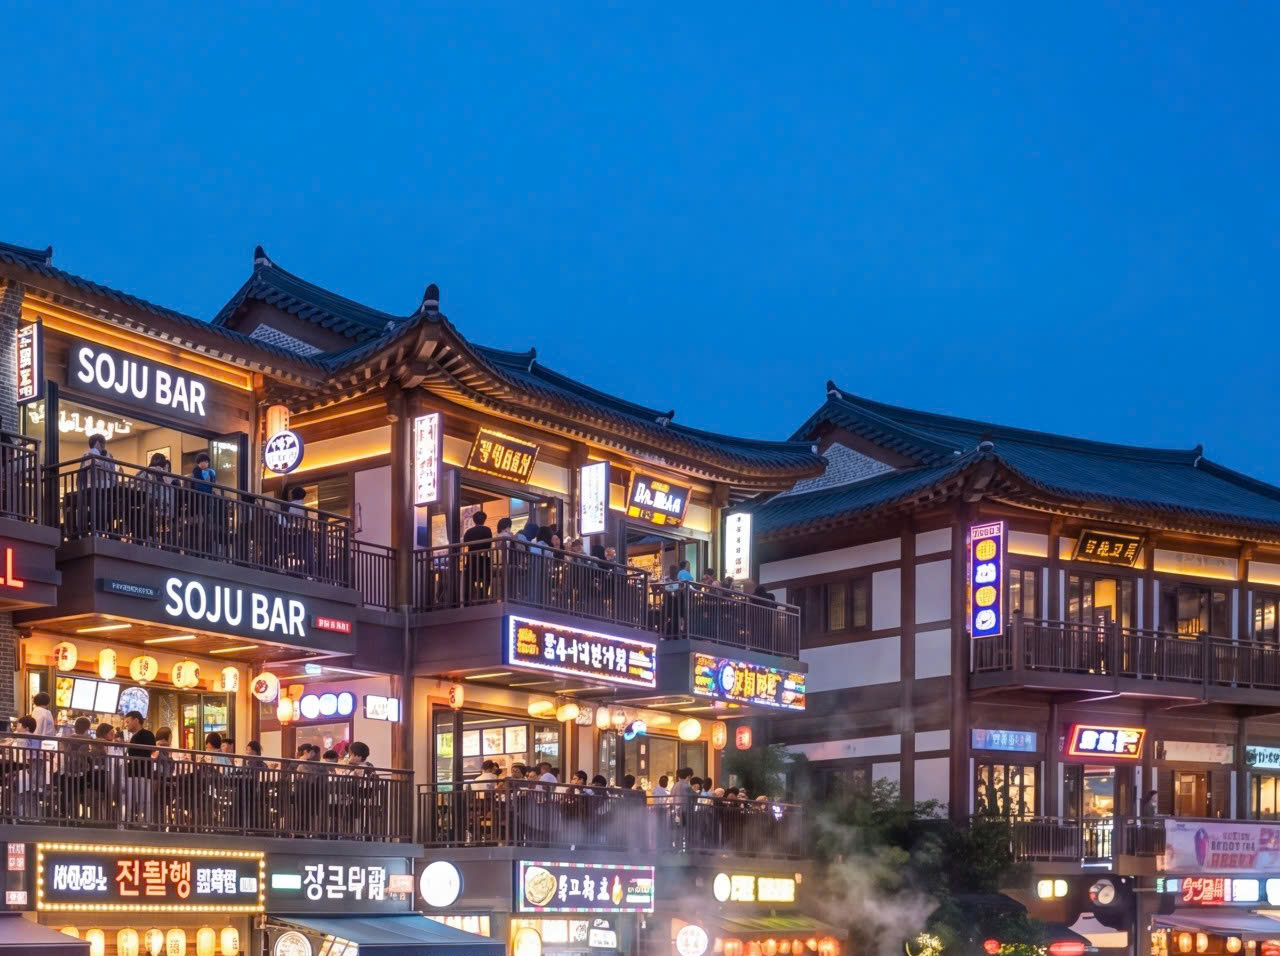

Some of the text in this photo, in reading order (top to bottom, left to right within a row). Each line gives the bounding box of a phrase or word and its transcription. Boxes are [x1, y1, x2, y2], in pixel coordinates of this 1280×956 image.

[77, 347, 149, 399] SOJU
[155, 369, 206, 417] BAR
[165, 577, 306, 637] SOJU BAR
